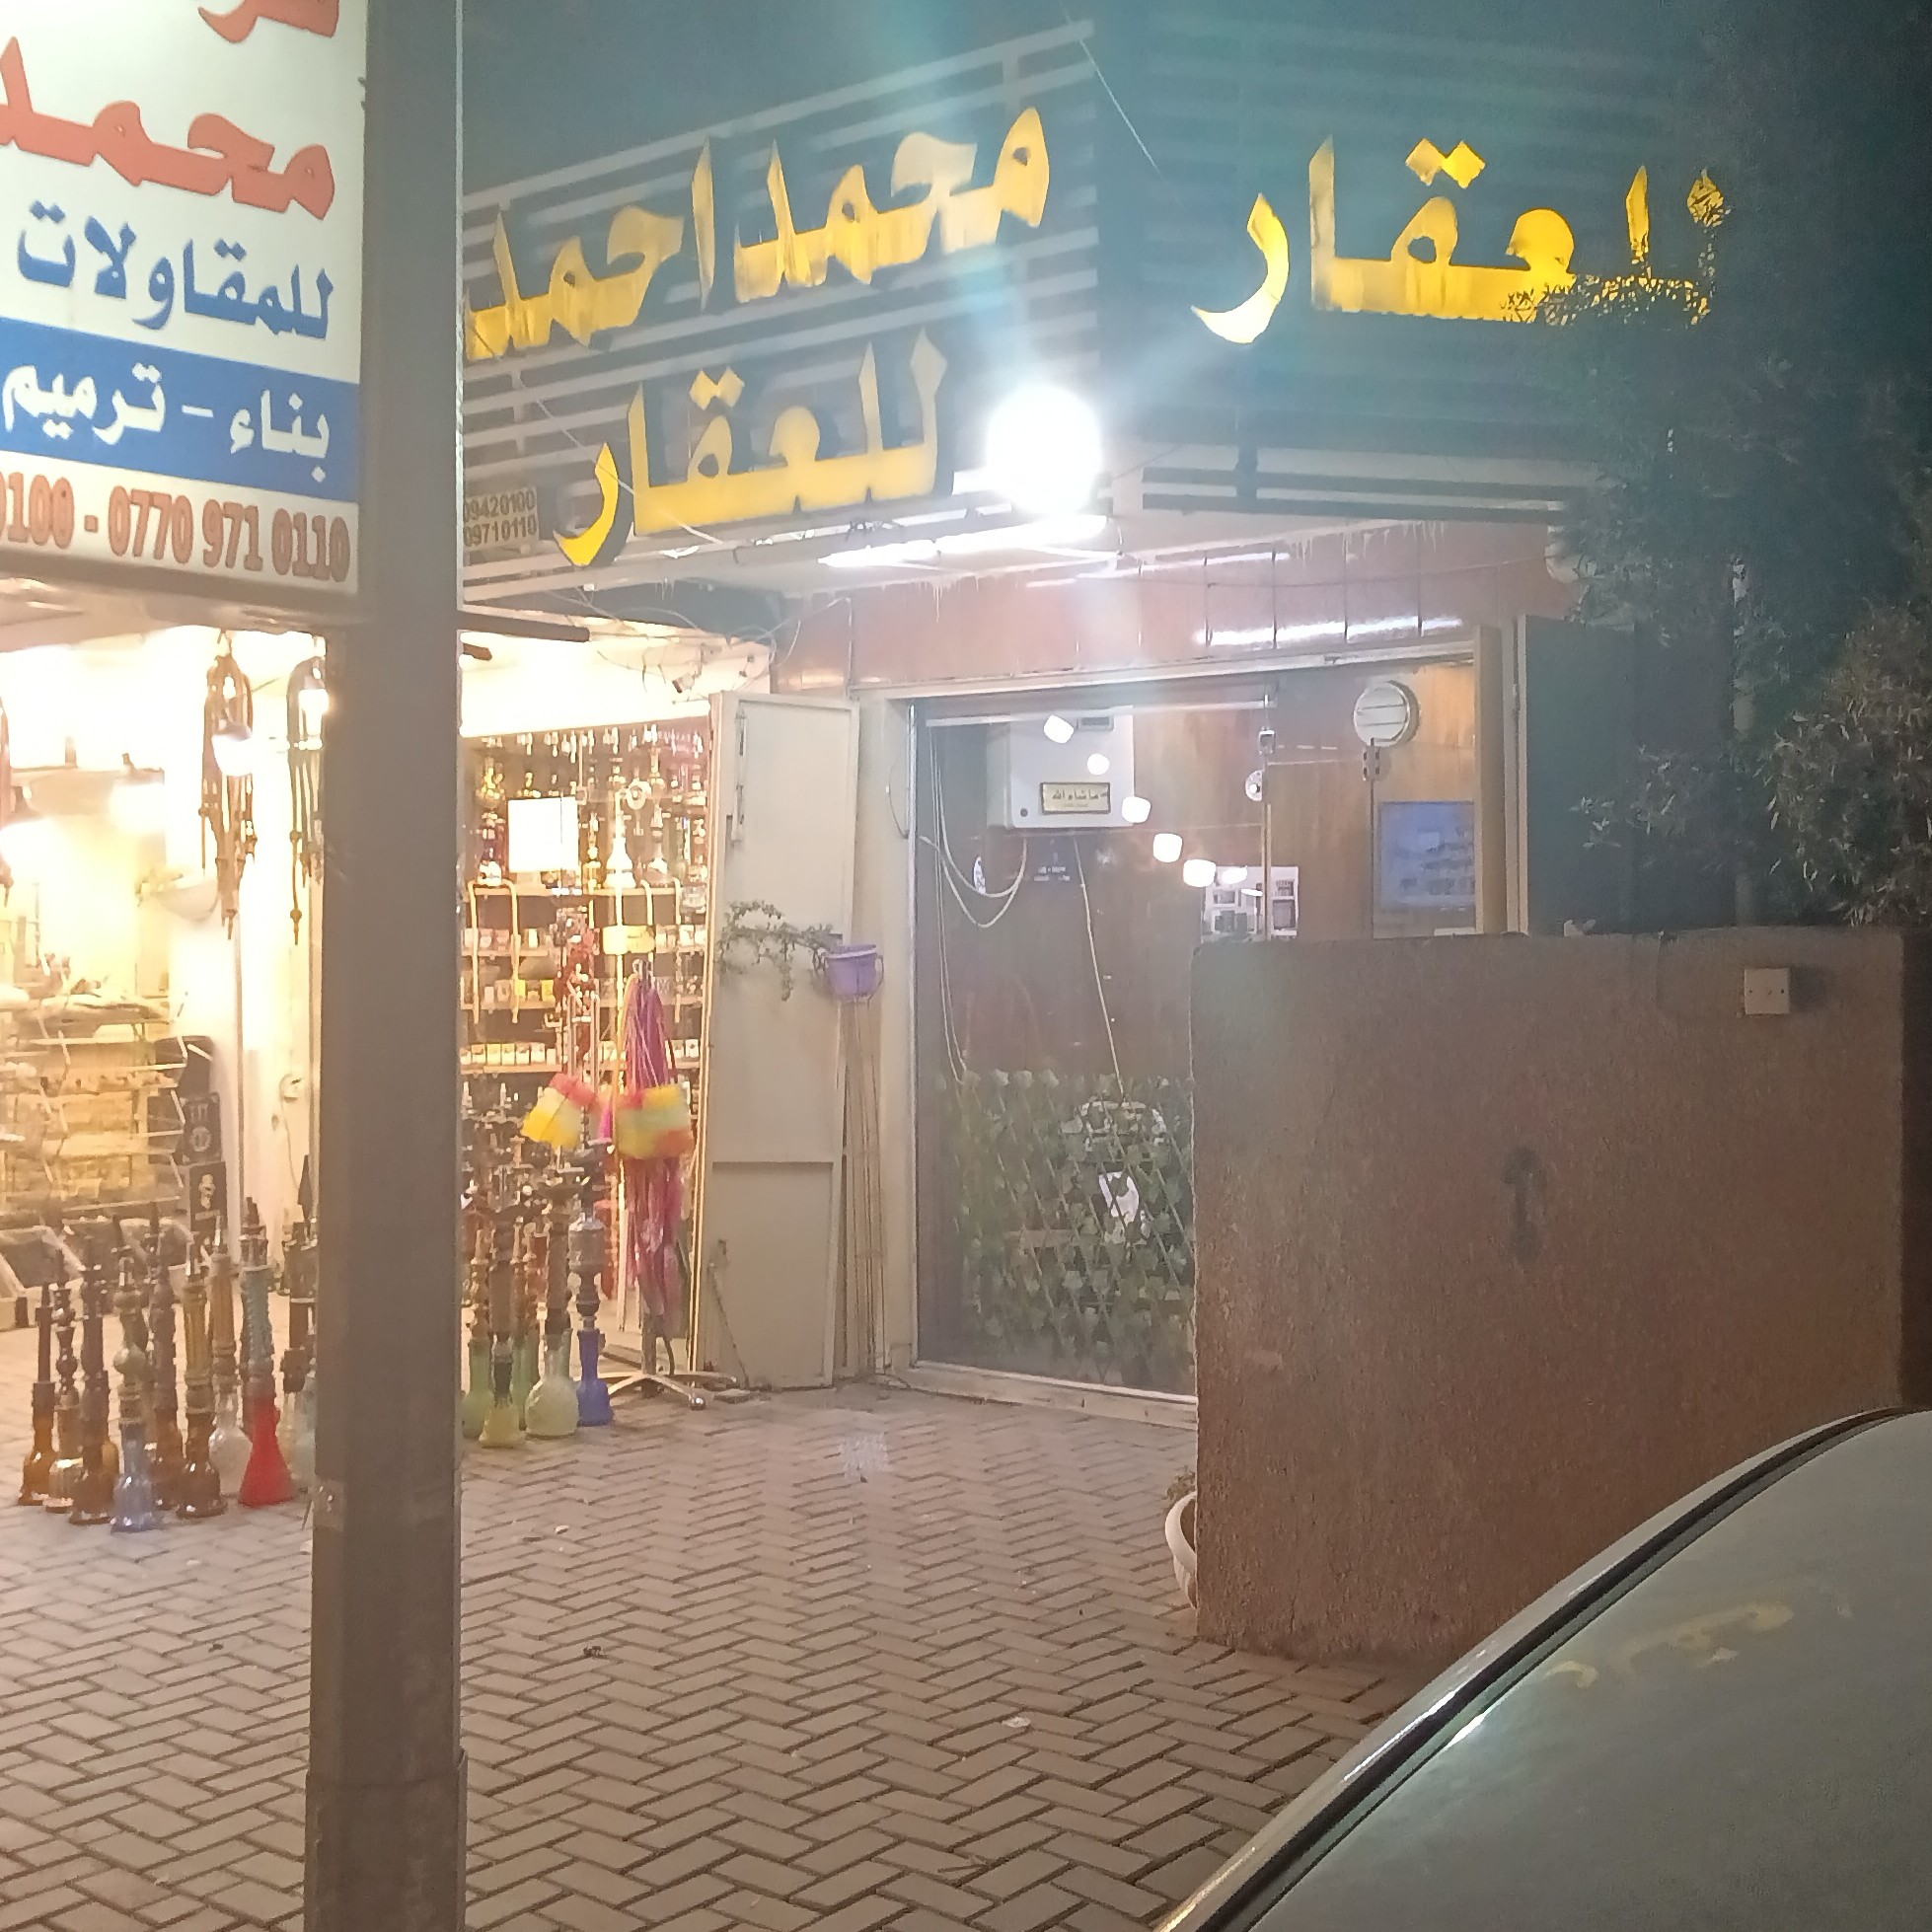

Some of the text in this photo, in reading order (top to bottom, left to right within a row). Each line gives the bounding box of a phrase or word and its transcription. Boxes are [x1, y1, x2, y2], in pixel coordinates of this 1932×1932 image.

[733, 107, 1050, 304] محمد
[17, 200, 334, 341] للمقاولات
[1, 361, 167, 446] ترميم
[230, 389, 331, 483] بناء
[552, 326, 948, 567] للعقار
[108, 484, 194, 565] 0770
[202, 498, 263, 572] 971
[271, 507, 351, 583] 0110
